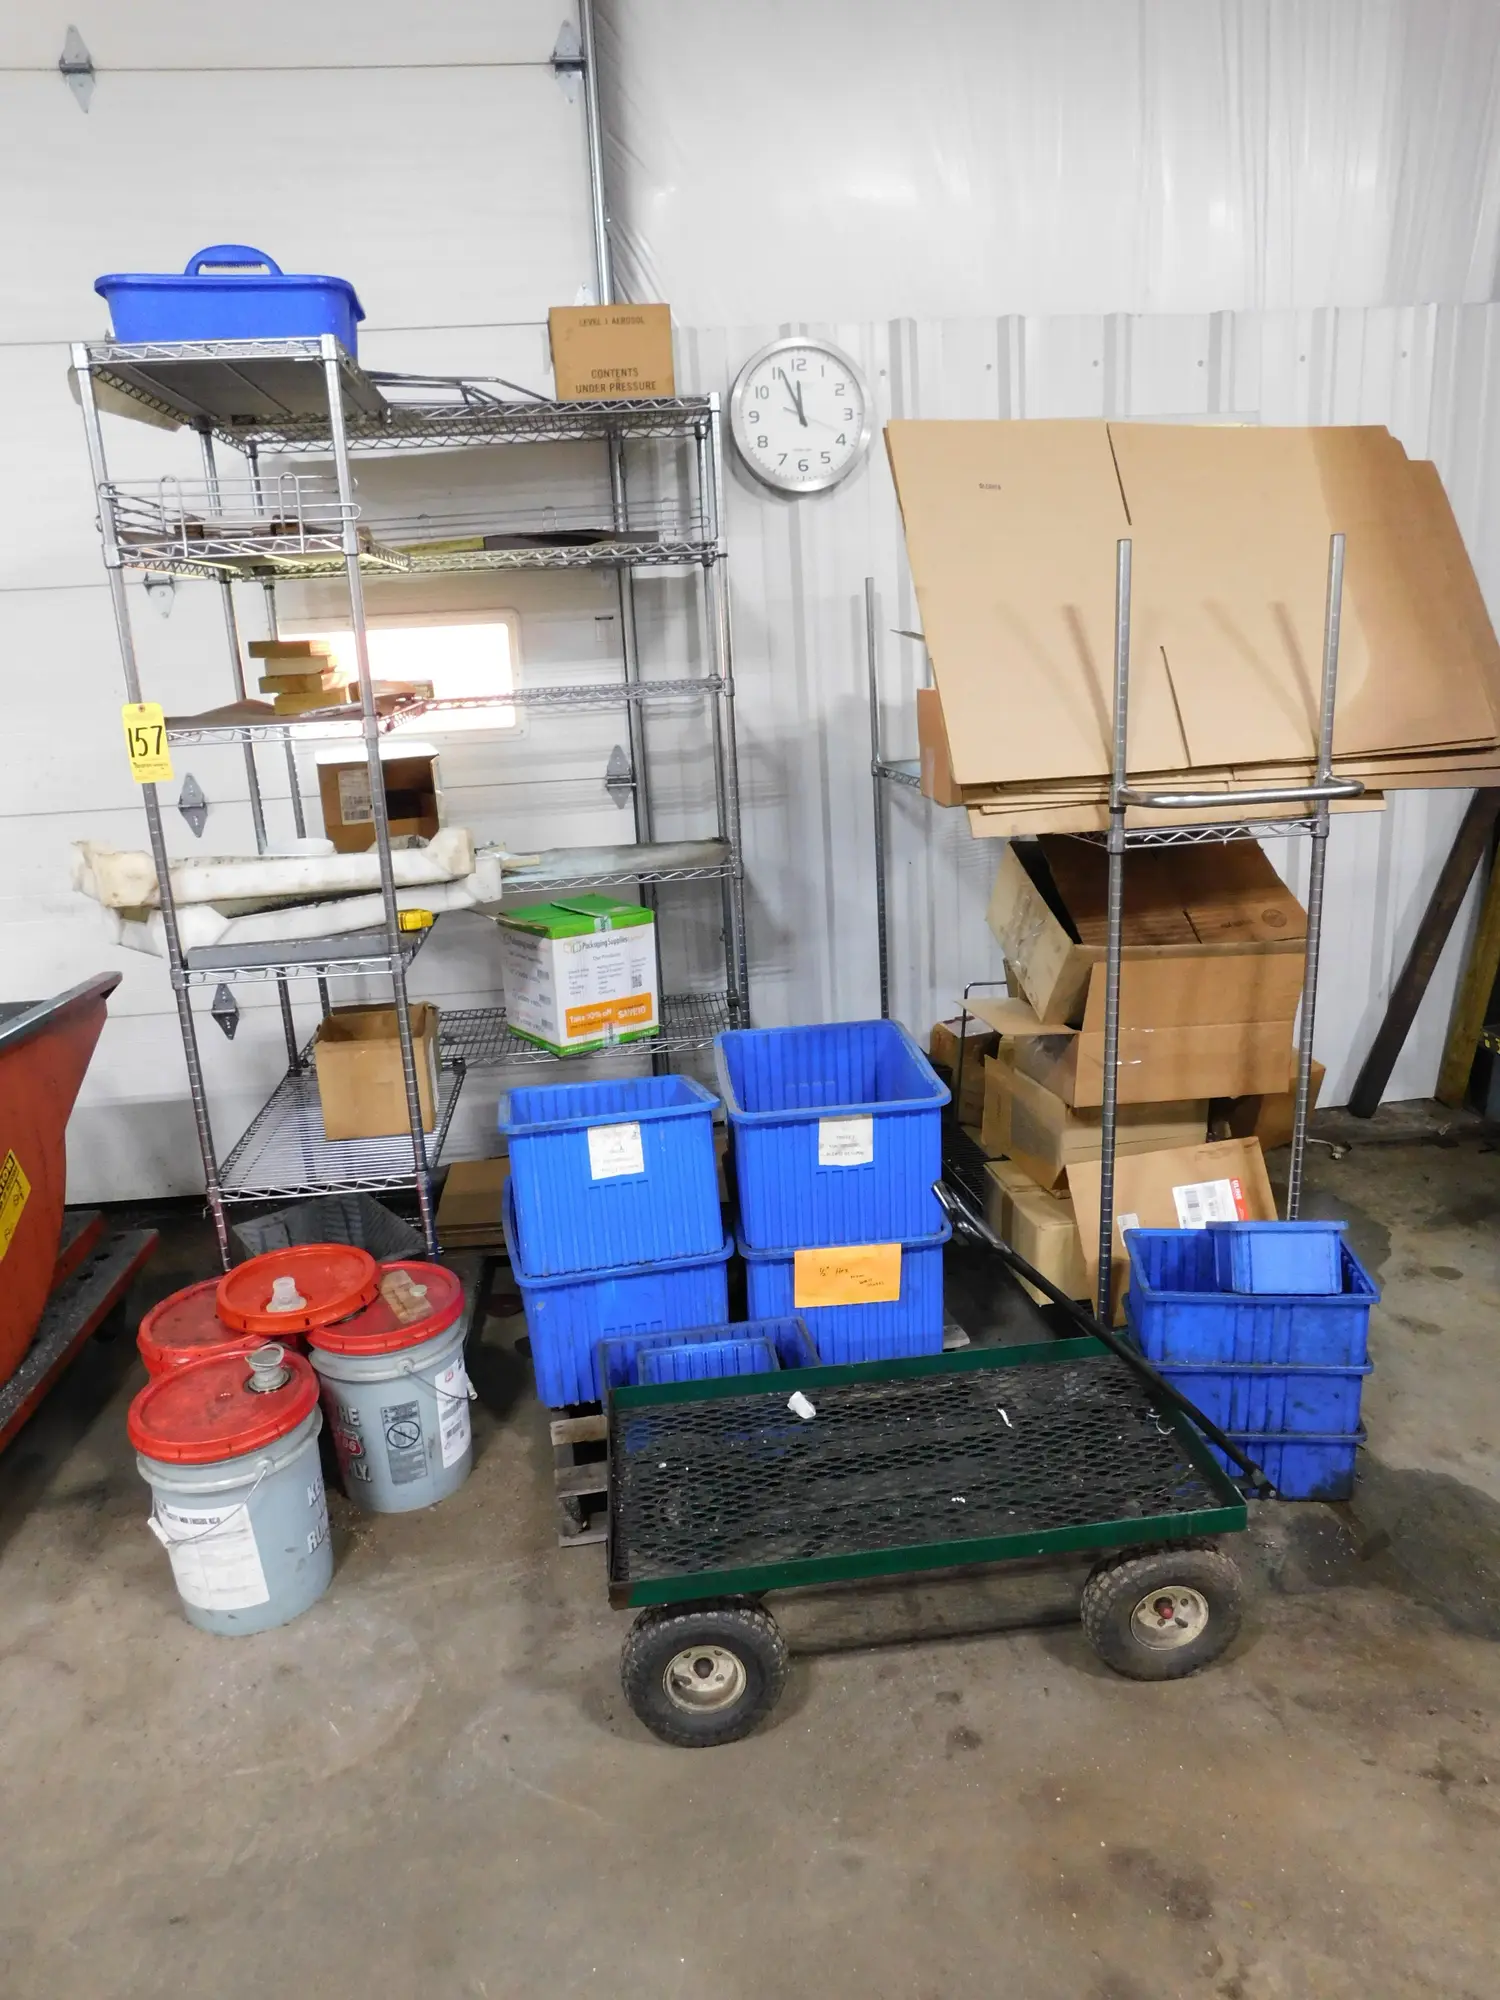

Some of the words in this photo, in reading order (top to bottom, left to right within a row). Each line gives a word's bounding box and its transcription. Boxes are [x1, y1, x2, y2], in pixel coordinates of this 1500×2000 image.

[579, 318, 602, 327] LEVEL
[611, 316, 644, 325] AEROSOL
[791, 358, 807, 372] 12
[591, 367, 639, 379] CONTENTS
[575, 383, 606, 394] UNDER
[609, 381, 657, 392] PRESSURE
[755, 385, 770, 400] 10
[834, 383, 845, 396] 2
[748, 410, 760, 424] 9
[843, 408, 853, 421] 3
[757, 435, 768, 448] 8
[835, 433, 847, 446] 4
[777, 453, 788, 466] 7
[820, 451, 831, 464] 5
[797, 459, 809, 472] 6
[128, 725, 163, 758] 157
[1231, 1179, 1242, 1200] ULINE
